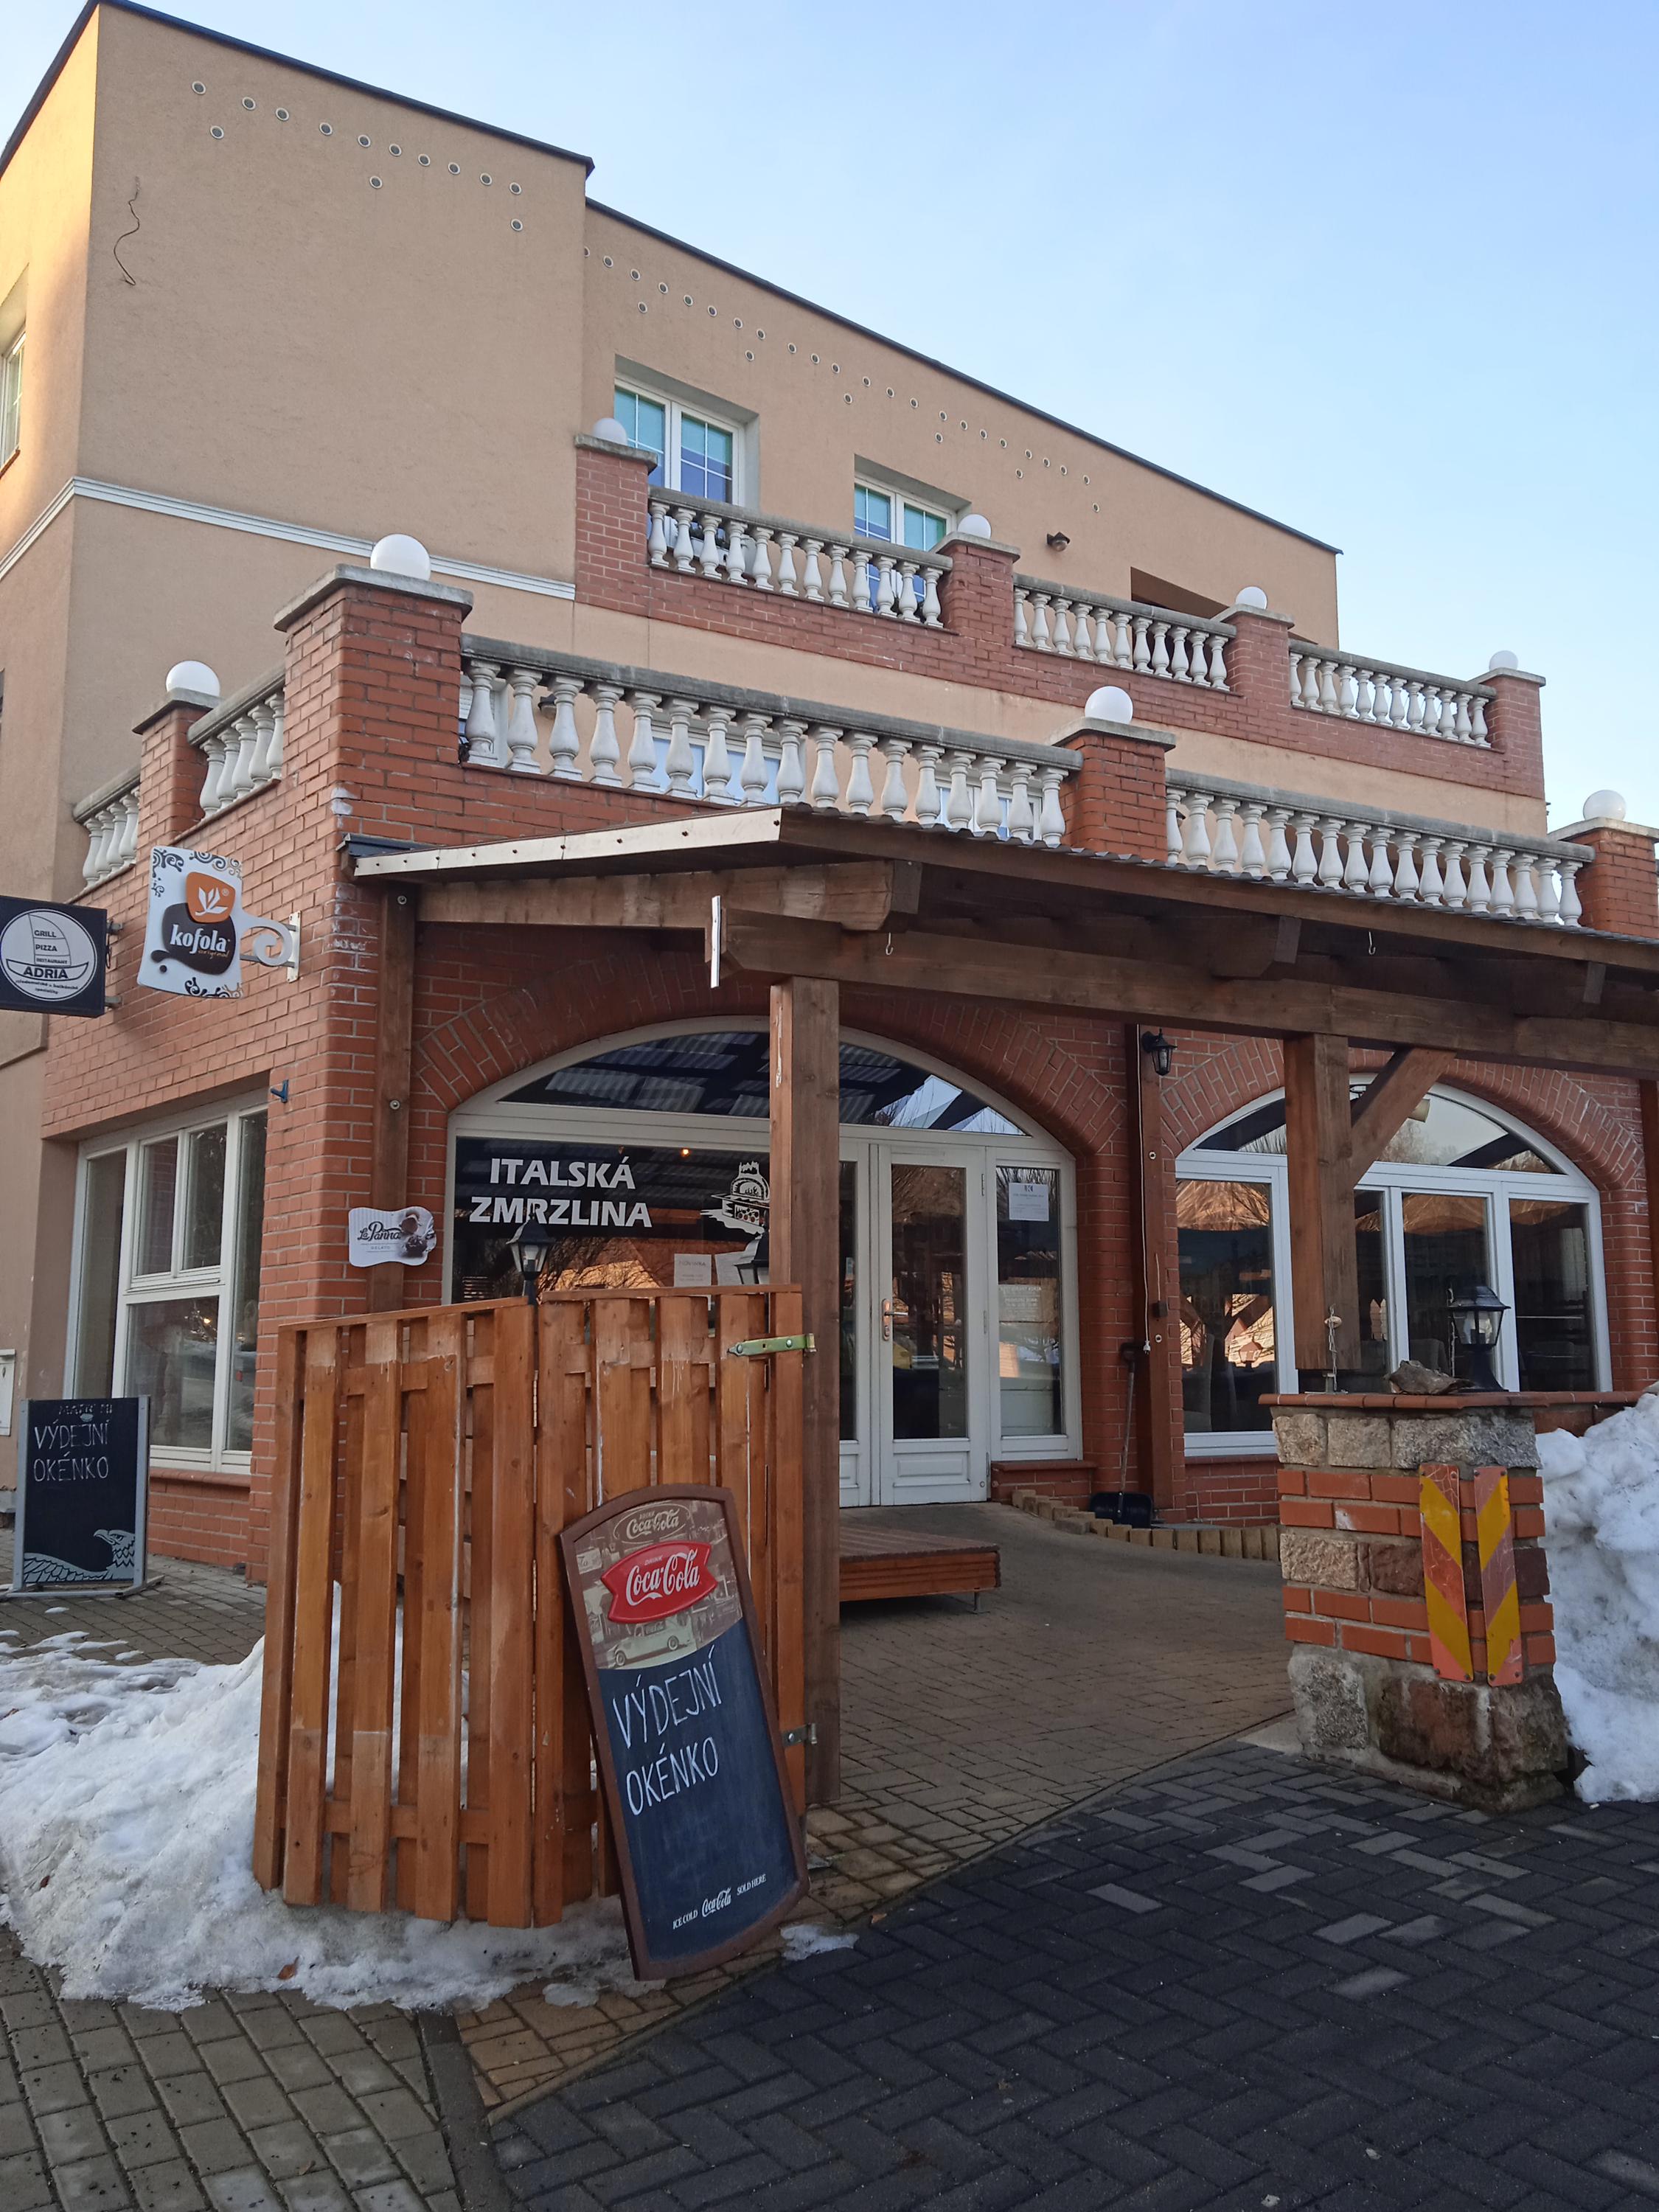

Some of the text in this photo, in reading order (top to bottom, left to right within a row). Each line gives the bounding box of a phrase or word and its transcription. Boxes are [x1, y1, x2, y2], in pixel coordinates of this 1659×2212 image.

[34, 930, 57, 938] GRILL
[35, 944, 58, 952] PIZZA
[170, 924, 227, 954] kofola
[23, 966, 69, 979] ADRIA
[490, 1156, 636, 1189] ITALSKÁ
[469, 1196, 653, 1228] ZMRZLINA
[357, 1221, 402, 1241] La Panna
[34, 1419, 110, 1450] VÝDEJNÍ
[33, 1451, 108, 1482] OKÉNKO
[644, 1555, 664, 1566] DRINK
[626, 1548, 700, 1606] Coca-Cola
[613, 1644, 722, 1749] VÝDEJNÍ
[626, 1736, 719, 1816] OKÉNKO
[672, 1917, 683, 1930] ICE
[682, 1910, 698, 1924] COLD
[737, 1882, 751, 1896] SOLD
[751, 1874, 767, 1888] HERE
